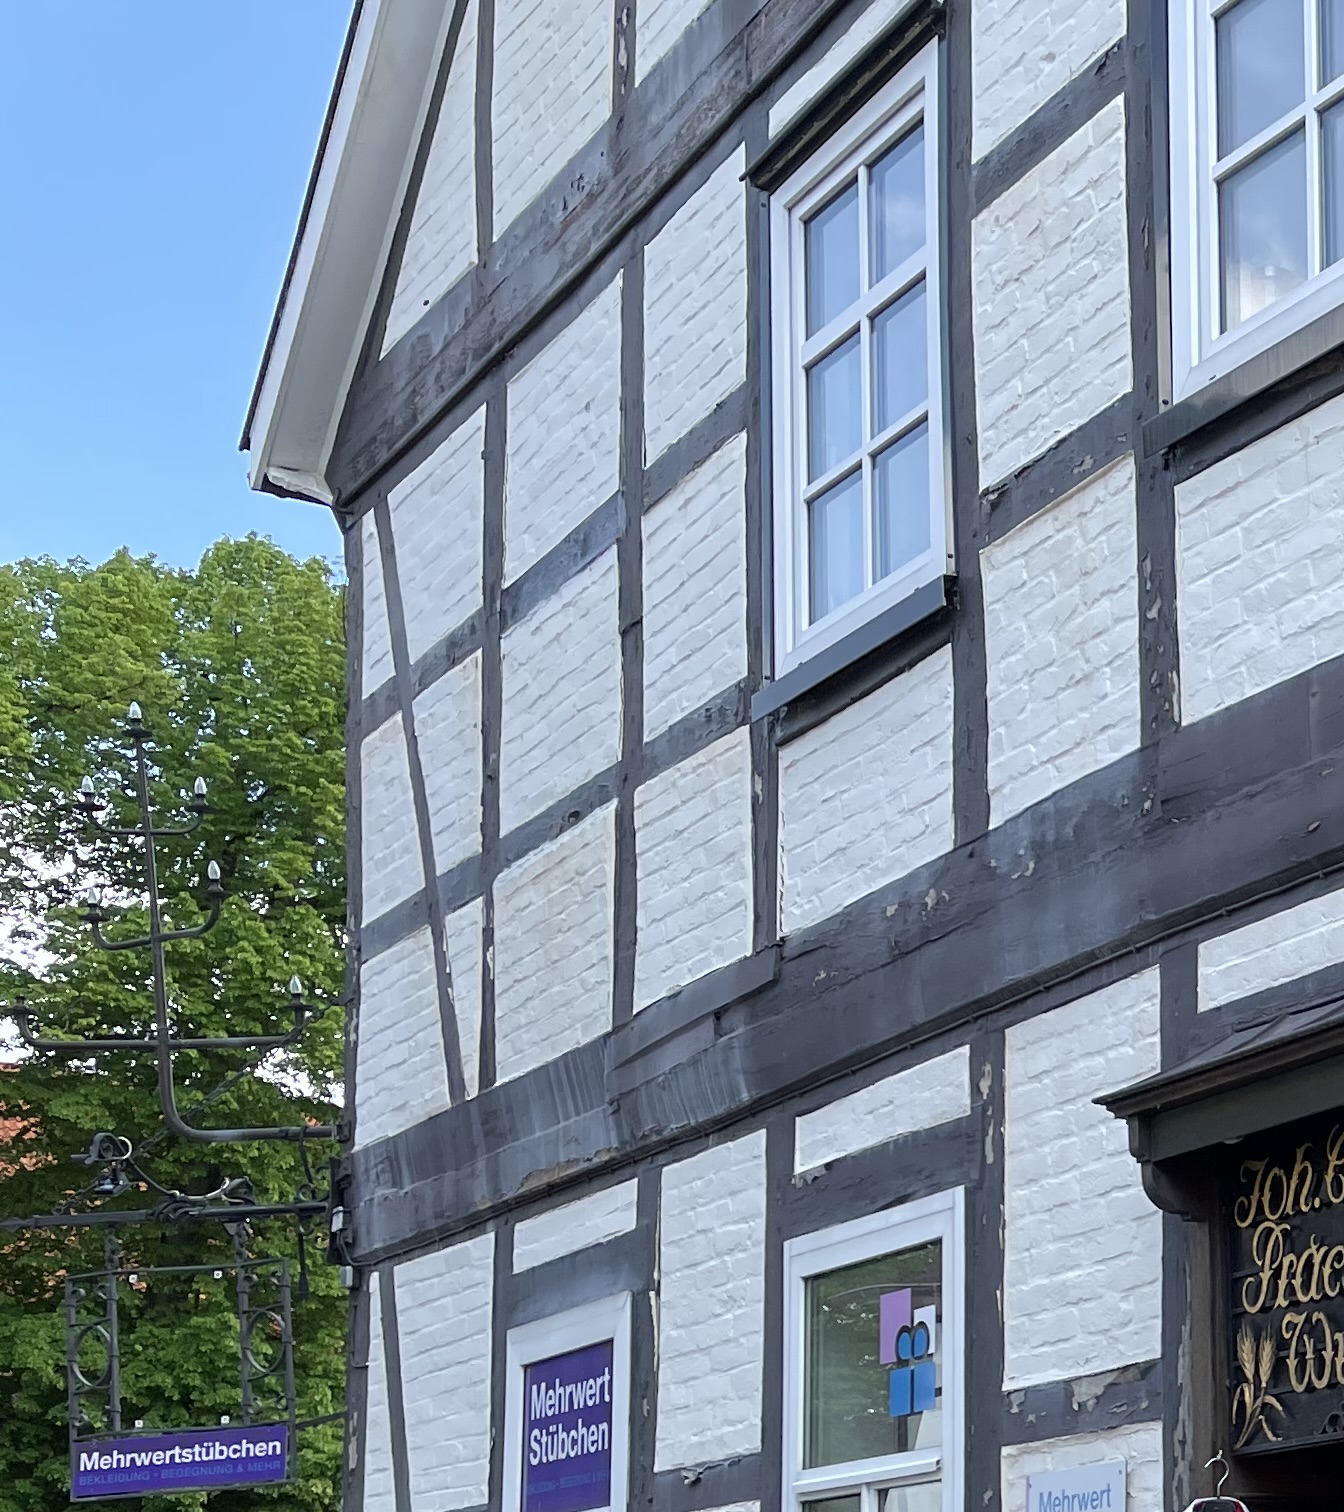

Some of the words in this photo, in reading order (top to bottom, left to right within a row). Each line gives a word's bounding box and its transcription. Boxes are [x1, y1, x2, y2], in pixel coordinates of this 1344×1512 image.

[530, 1366, 611, 1421] Mehrwert
[79, 1439, 282, 1472] Mehrwertstübchen
[529, 1418, 609, 1466] Stübchen
[78, 1471, 150, 1487] BEKLEIDUNG
[160, 1465, 234, 1480] BEGEGNUNG
[247, 1461, 281, 1473] MEHR
